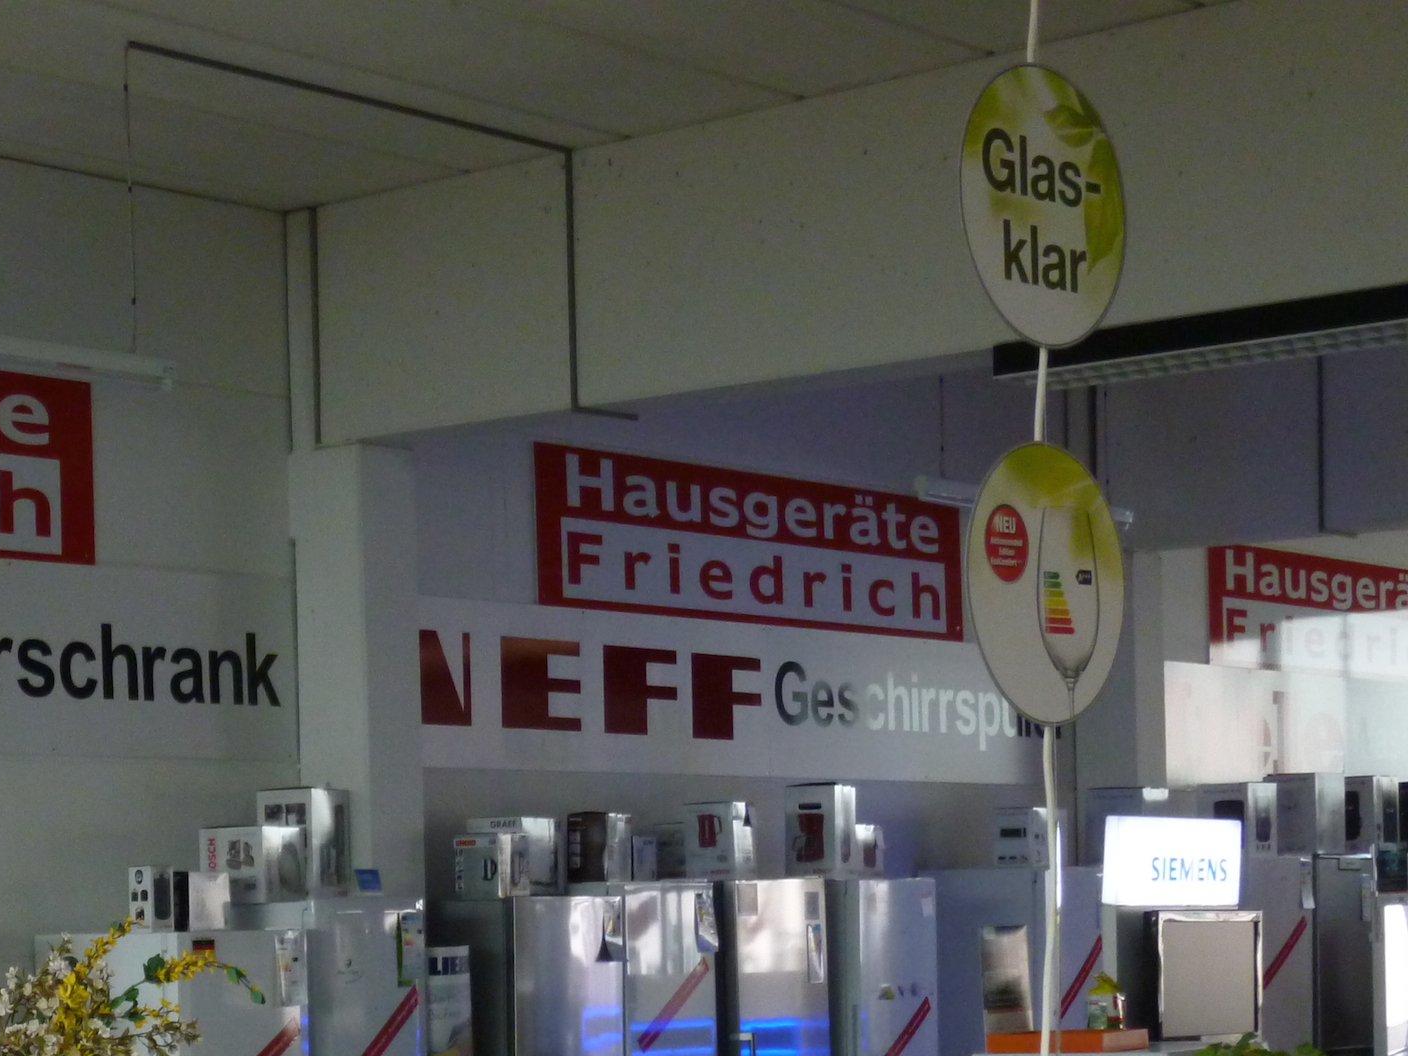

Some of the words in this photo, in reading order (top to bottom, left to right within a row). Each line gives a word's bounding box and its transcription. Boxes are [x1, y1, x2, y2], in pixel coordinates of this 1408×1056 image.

[981, 127, 1103, 208] Glas-
[1002, 217, 1088, 295] klar
[564, 452, 940, 554] Hausgeräte
[994, 515, 1016, 534] NEU
[566, 531, 941, 621] Friedrich
[418, 628, 763, 740] NEFF
[208, 837, 217, 872] OSCH
[1151, 856, 1228, 883] SIEMENS
